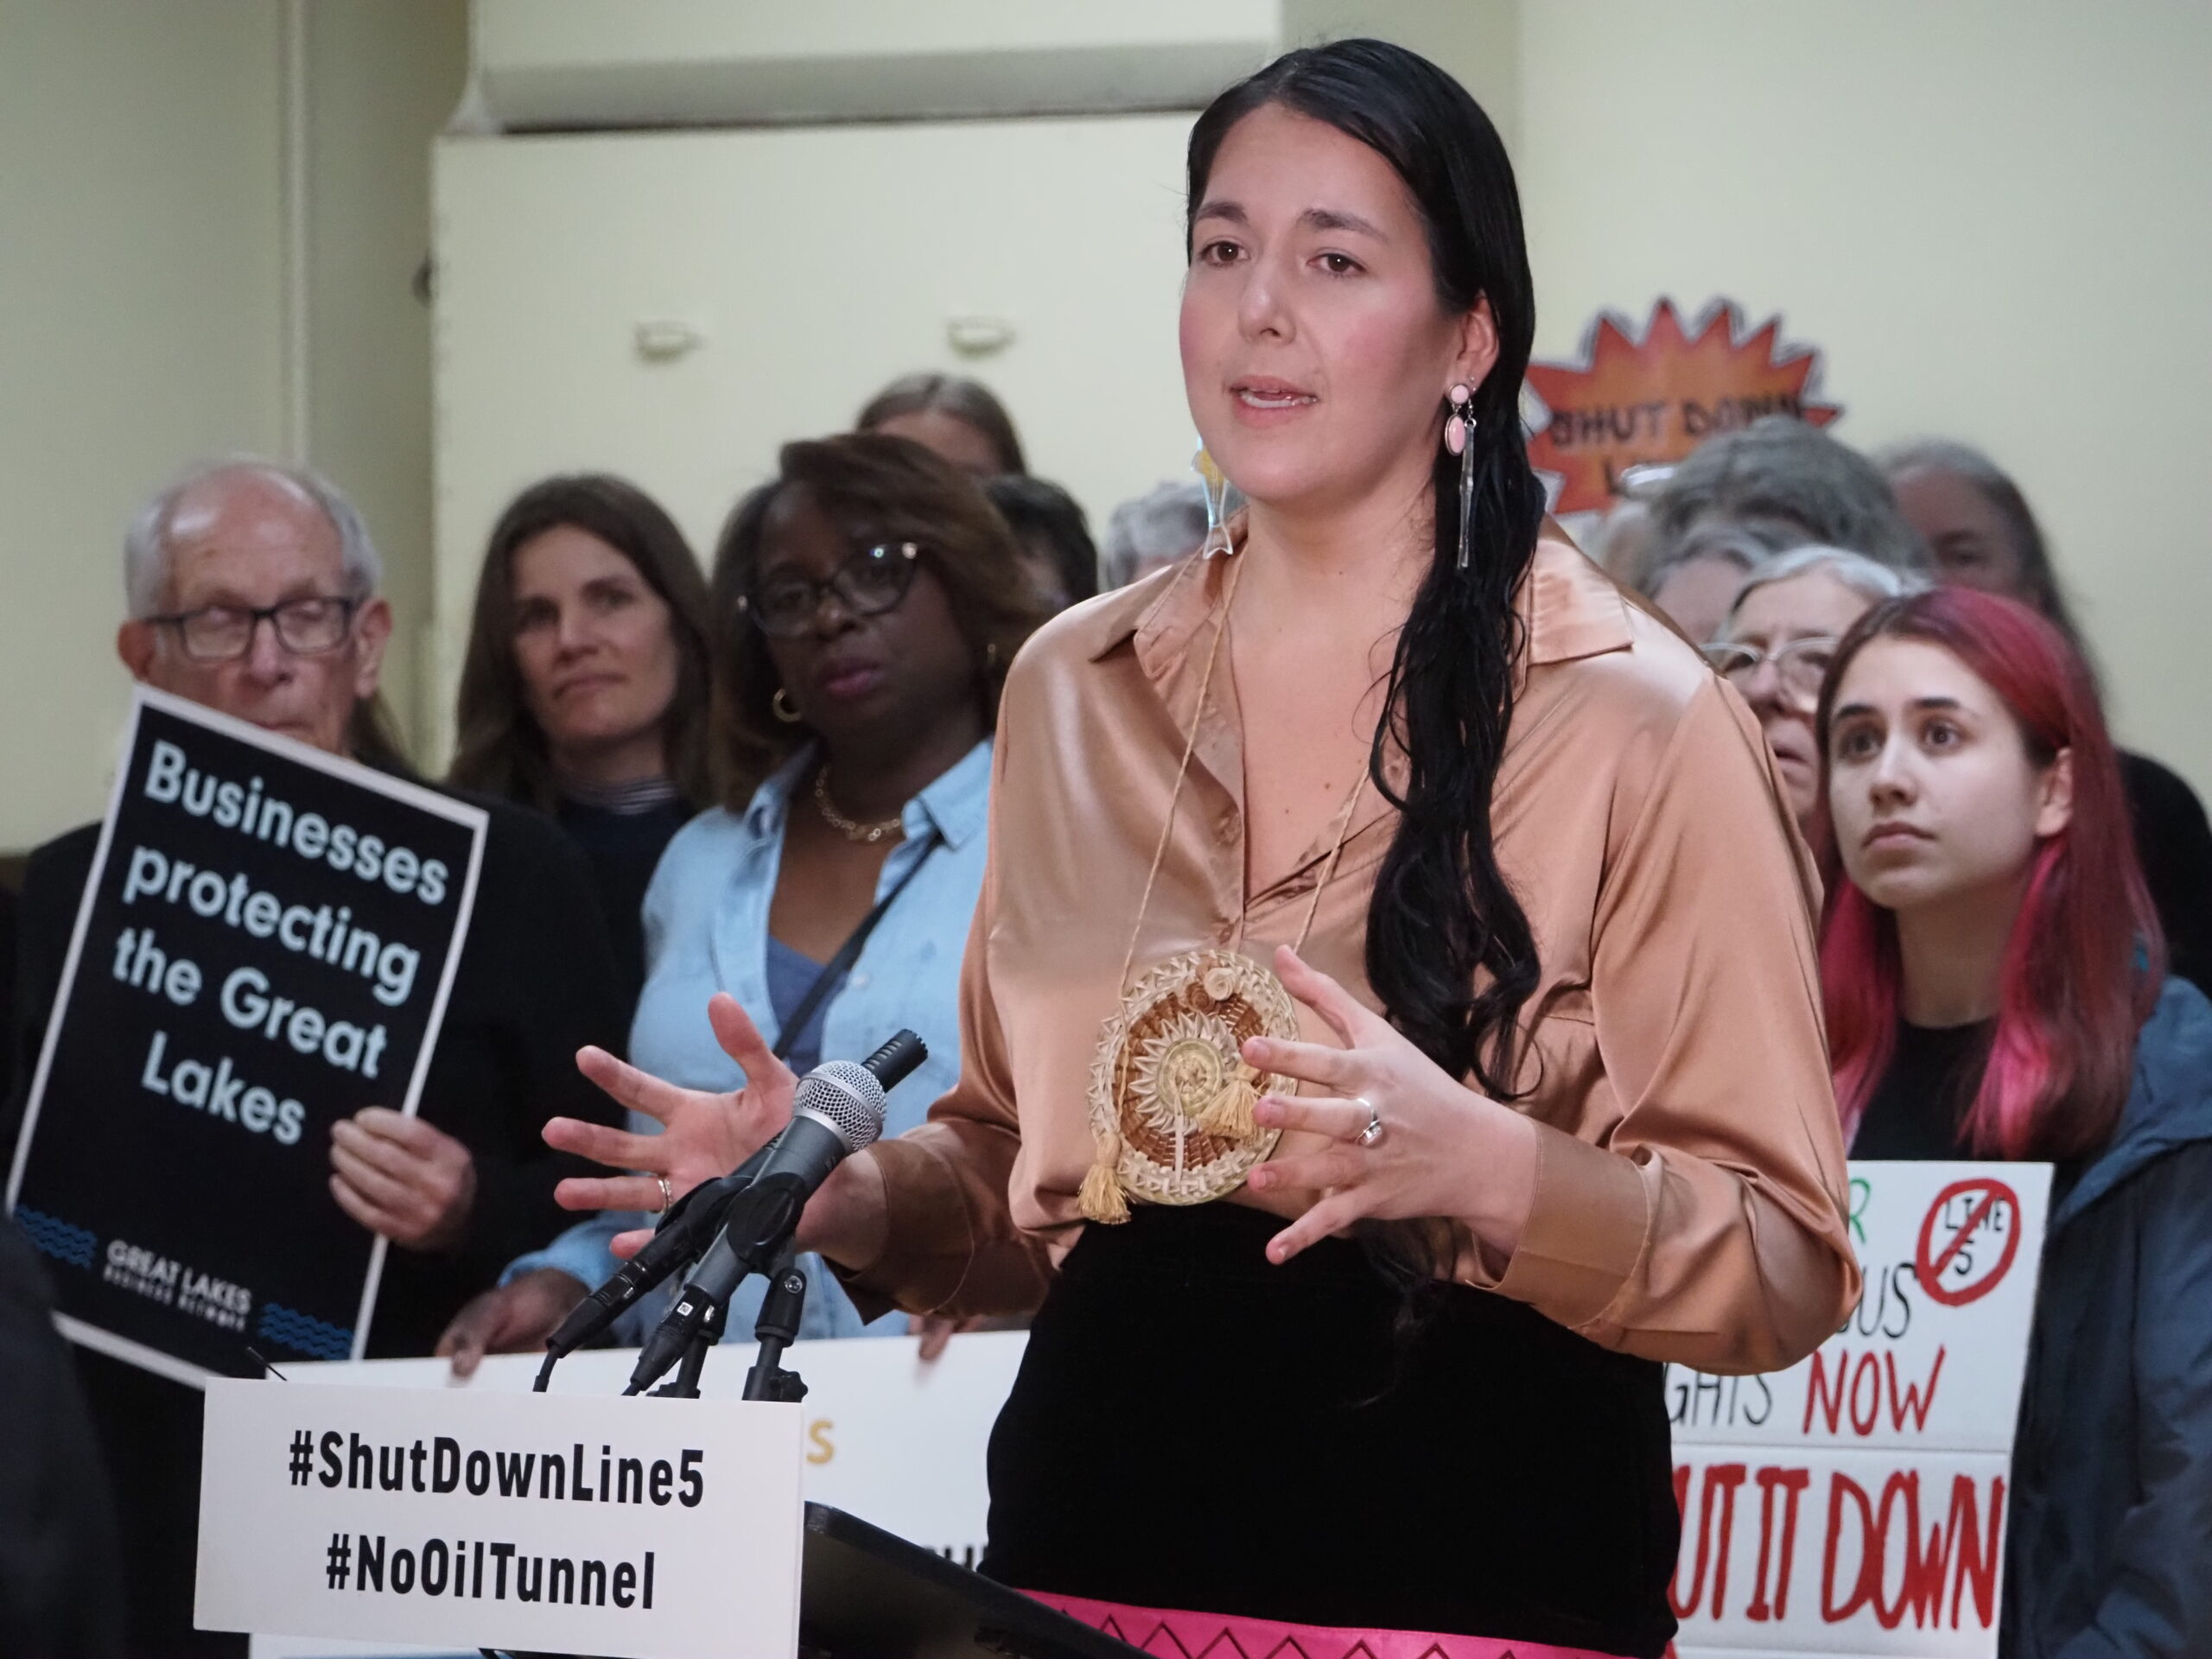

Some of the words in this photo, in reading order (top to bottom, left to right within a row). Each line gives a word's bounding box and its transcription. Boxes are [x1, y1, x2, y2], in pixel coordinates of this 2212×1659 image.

[1552, 398, 1664, 448] SHUT
[144, 739, 449, 905] Businesses
[123, 845, 421, 1006] protecting
[113, 927, 202, 1005] the
[220, 967, 387, 1078] Great
[141, 1031, 305, 1145] Lakes
[106, 1239, 181, 1286] GREAT
[181, 1267, 251, 1316] LAKES
[1803, 1344, 1945, 1436] NOW
[289, 1428, 704, 1507] #ShutDownLine5
[326, 1532, 656, 1610] #NoOilTunnel
[1745, 1466, 1809, 1623] IT
[1821, 1469, 2005, 1630] DOWN
